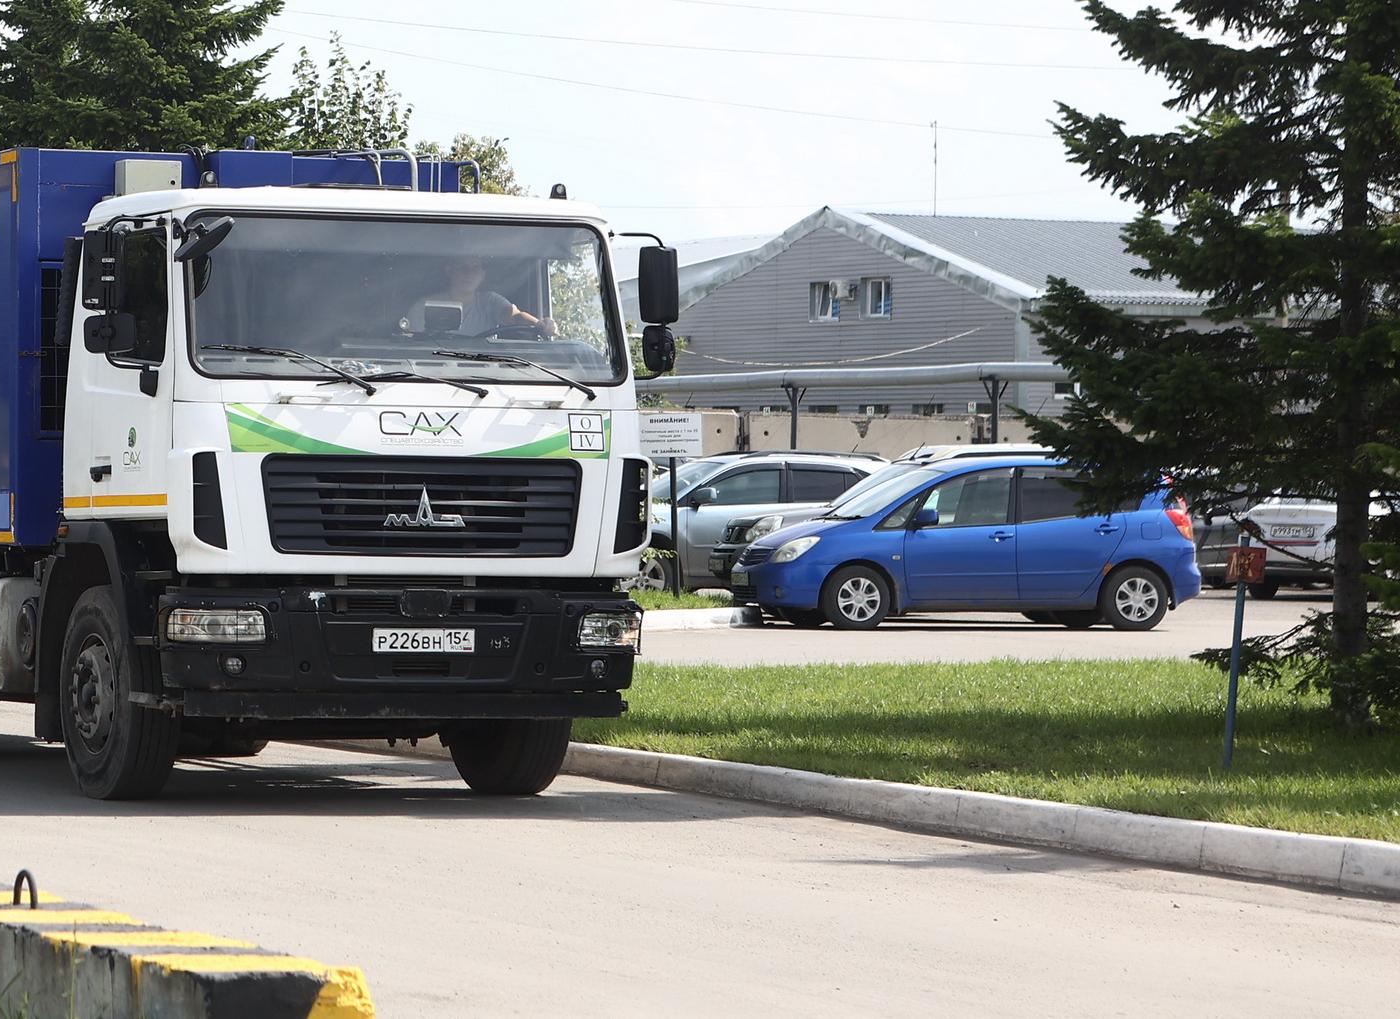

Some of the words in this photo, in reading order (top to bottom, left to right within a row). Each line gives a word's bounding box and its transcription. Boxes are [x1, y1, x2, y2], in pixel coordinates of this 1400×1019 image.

[379, 410, 463, 437] САХ
[579, 434, 595, 448] IV
[123, 450, 142, 466] САХ
[378, 632, 442, 650] Р226ВН
[446, 631, 470, 645] 154
